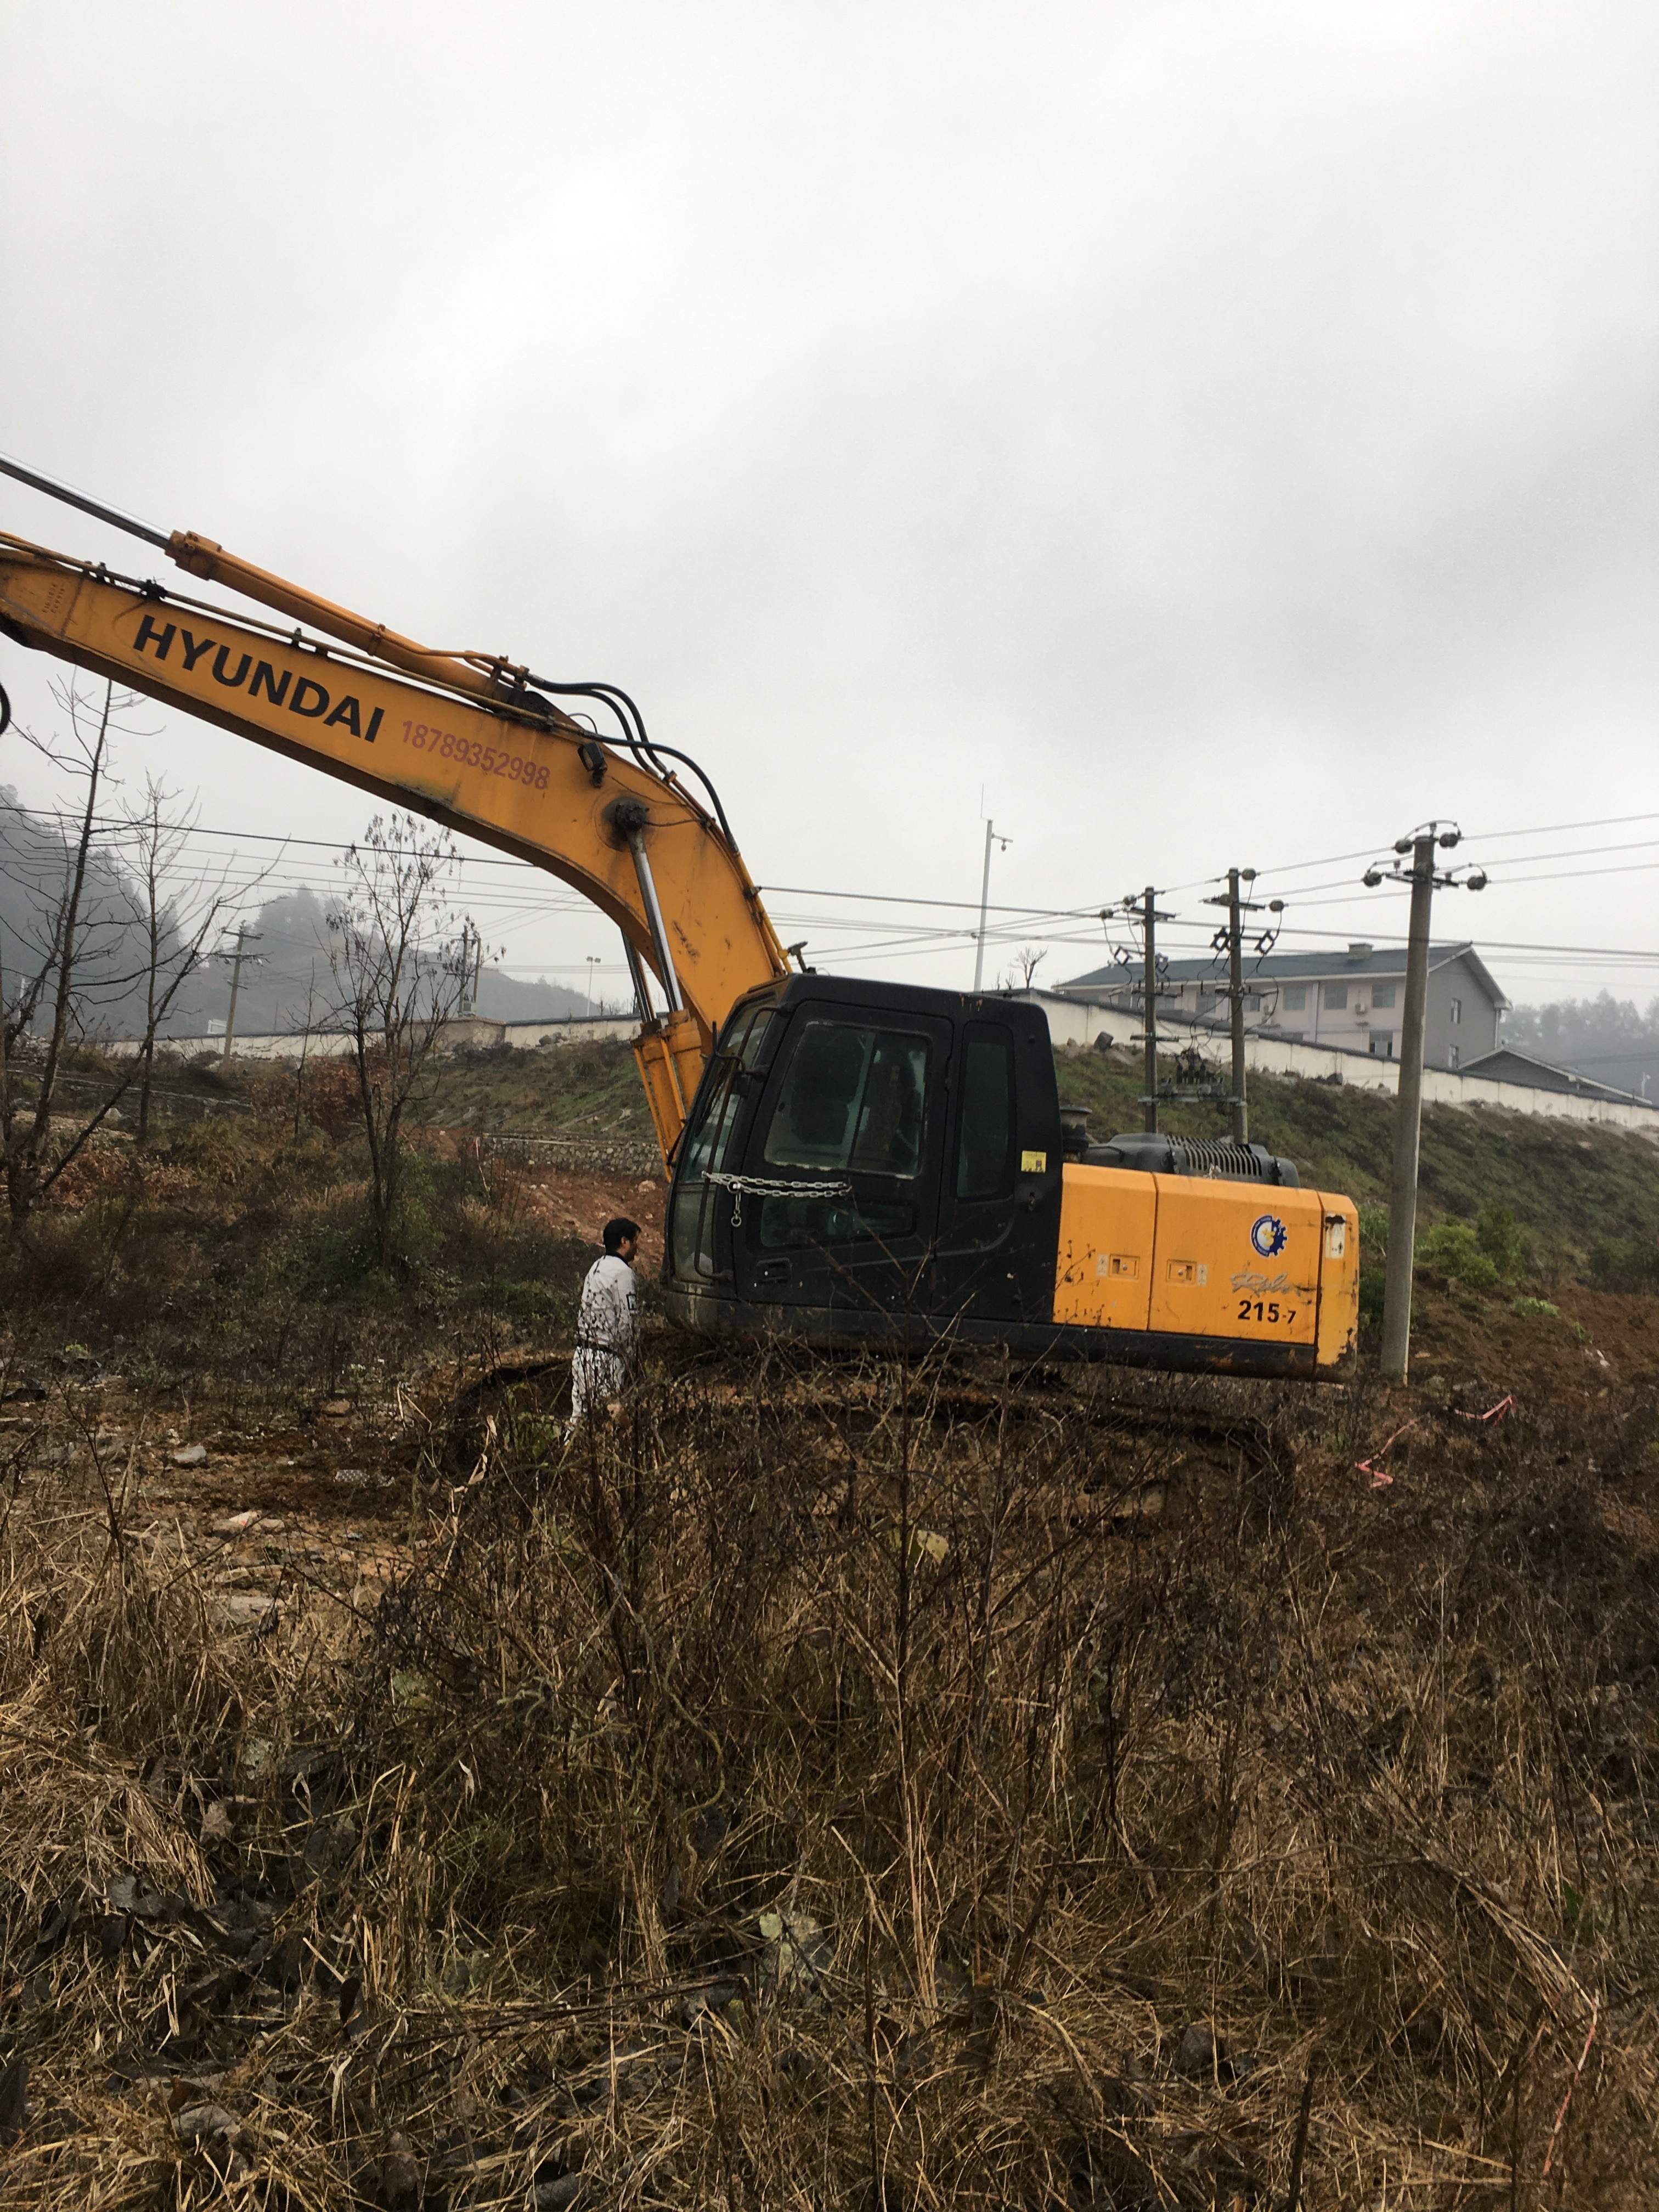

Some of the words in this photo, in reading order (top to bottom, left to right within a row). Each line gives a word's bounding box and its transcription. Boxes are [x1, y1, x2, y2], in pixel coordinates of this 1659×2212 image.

[133, 614, 385, 743] HYUNDAI
[402, 720, 551, 790] 18789352998
[1238, 1300, 1296, 1324] 215-7
